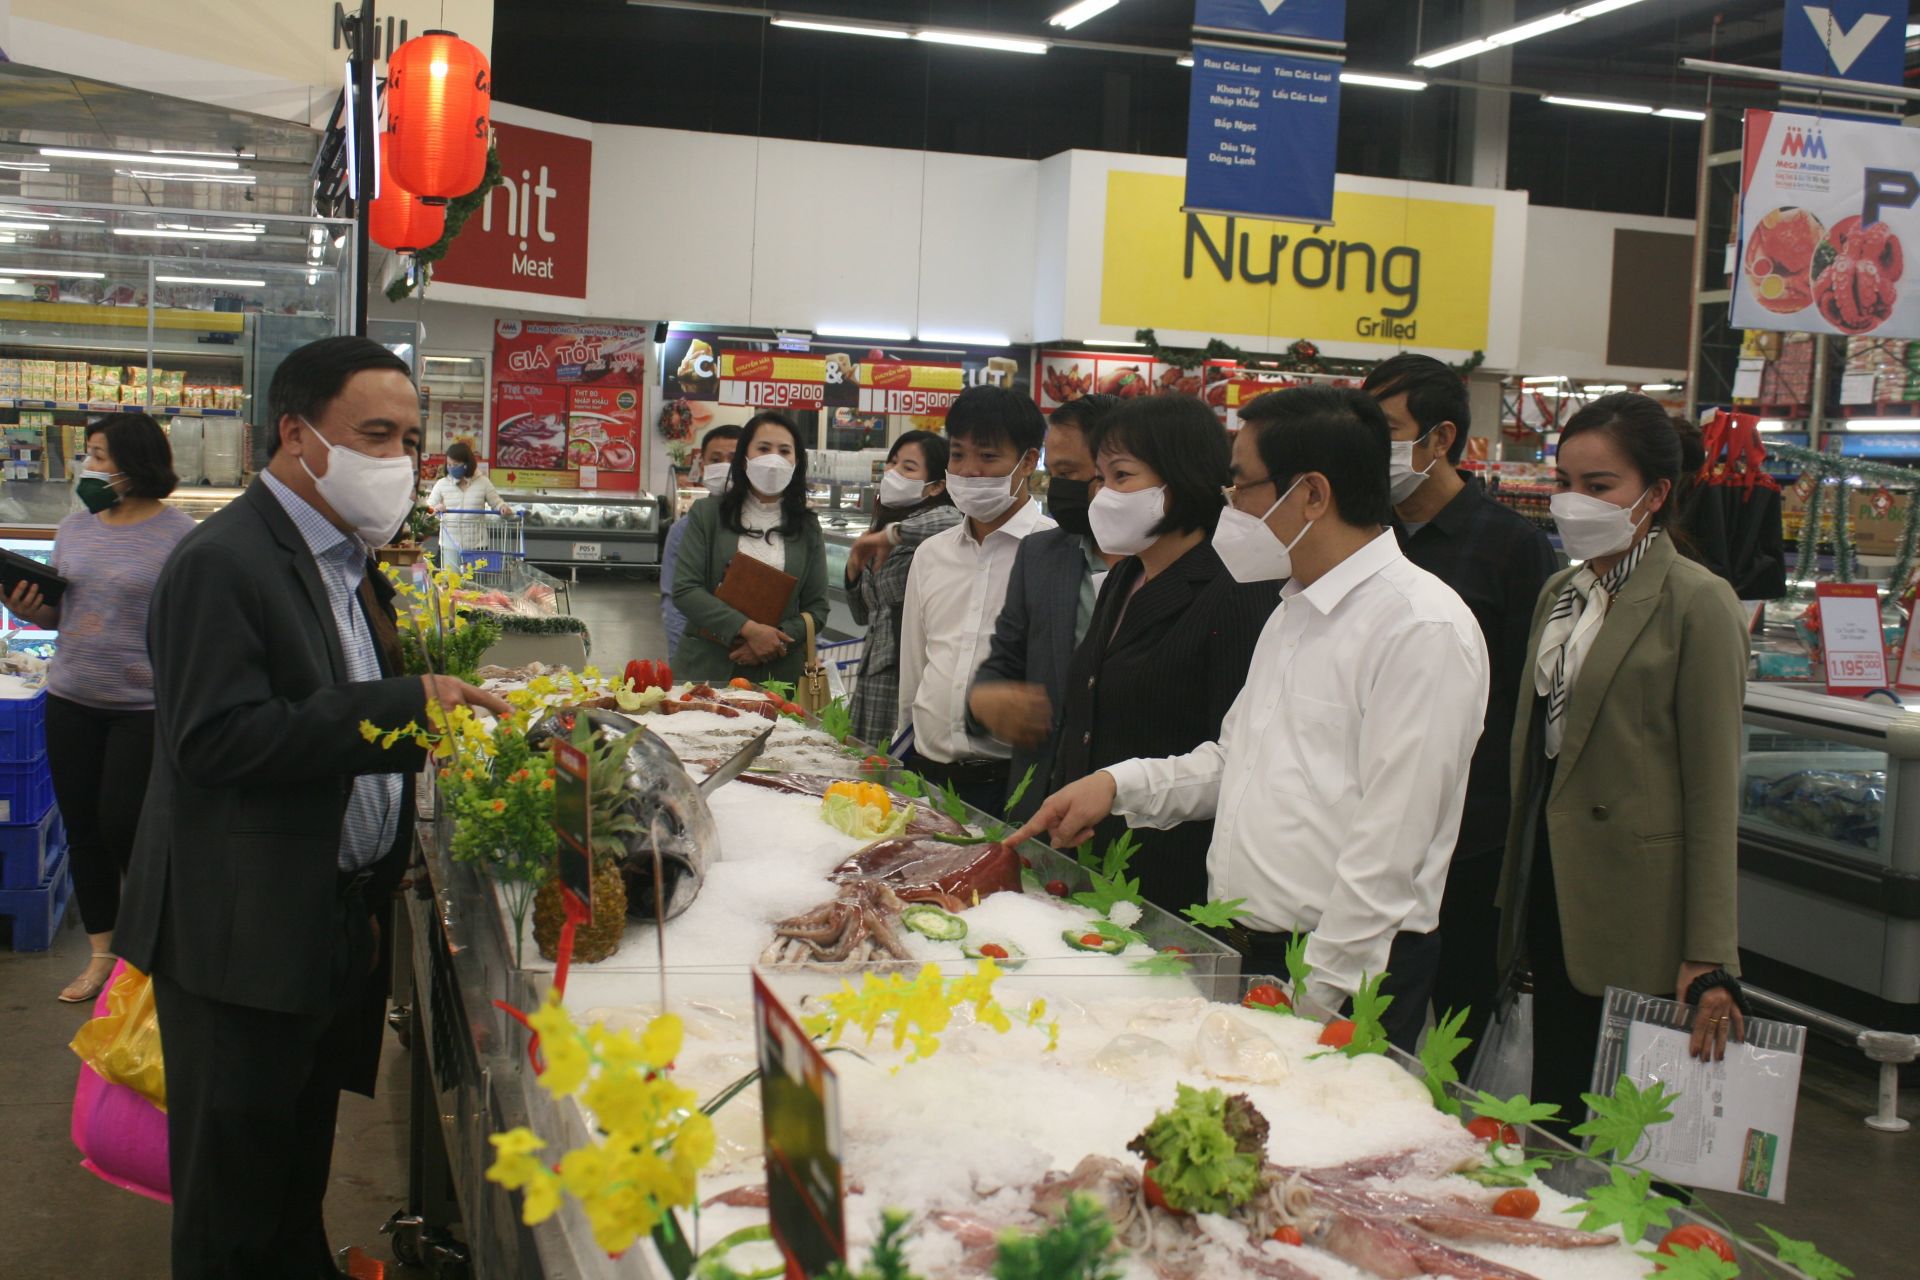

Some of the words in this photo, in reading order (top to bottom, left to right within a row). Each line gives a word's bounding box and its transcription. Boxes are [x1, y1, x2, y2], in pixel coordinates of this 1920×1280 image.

[1204, 59, 1221, 69] Rau
[1223, 62, 1240, 72] Các
[1274, 67, 1293, 78] Tôm
[1295, 70, 1311, 80] Các
[1217, 84, 1242, 96] Khoai
[1244, 86, 1260, 98] Tây
[1290, 91, 1307, 102] Các
[1234, 120, 1257, 132] Ngọt
[1240, 144, 1256, 155] Tây
[1209, 152, 1232, 166] Đông
[512, 253, 554, 279] Meat
[1184, 213, 1420, 318] Nướng
[1356, 316, 1416, 340] Grilled
[826, 361, 843, 384] &
